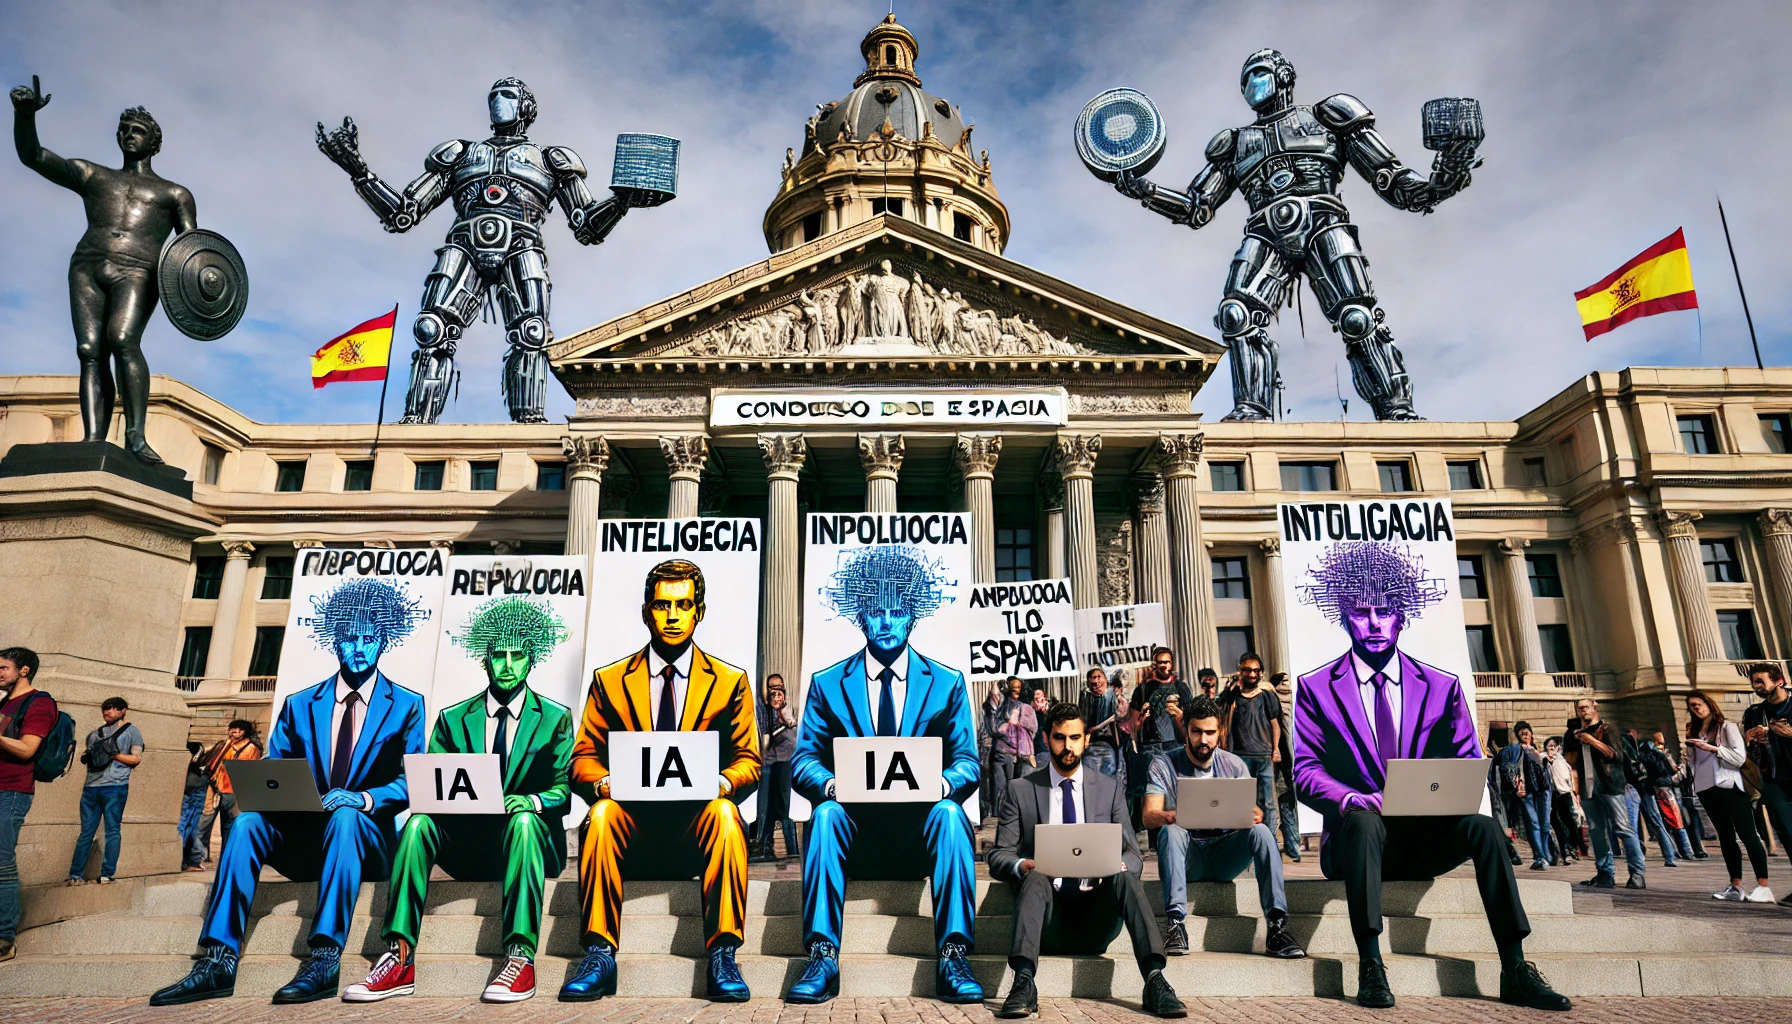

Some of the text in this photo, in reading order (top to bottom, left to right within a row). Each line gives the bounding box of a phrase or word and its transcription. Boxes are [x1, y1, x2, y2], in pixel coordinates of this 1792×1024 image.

[601, 519, 758, 552] INTELIGECIA
[1002, 609, 1044, 635] TLO
[434, 767, 479, 801] IA
[641, 746, 693, 788] IA
[865, 751, 920, 790] IA
